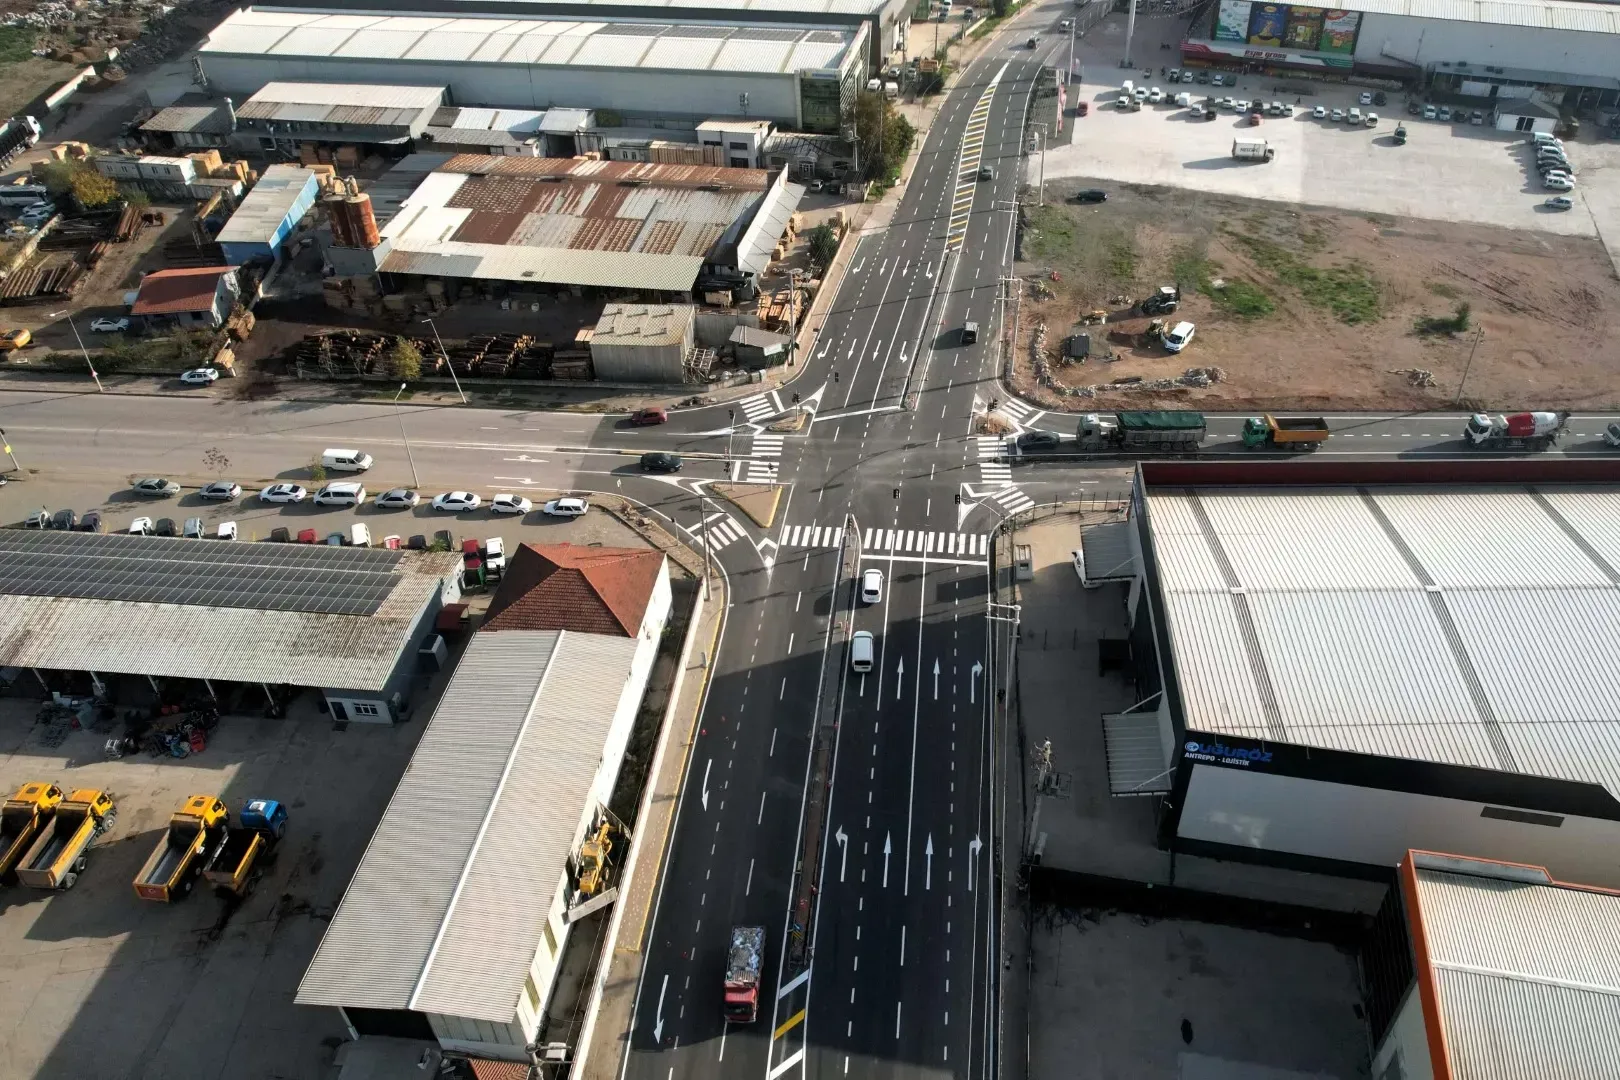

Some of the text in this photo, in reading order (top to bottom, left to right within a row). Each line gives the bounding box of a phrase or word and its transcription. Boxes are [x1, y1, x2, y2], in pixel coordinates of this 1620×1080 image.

[1184, 752, 1216, 761] ANTREPO
[1222, 757, 1251, 766] LOJİSTİK
[1199, 743, 1273, 762] UĞURÖZ
